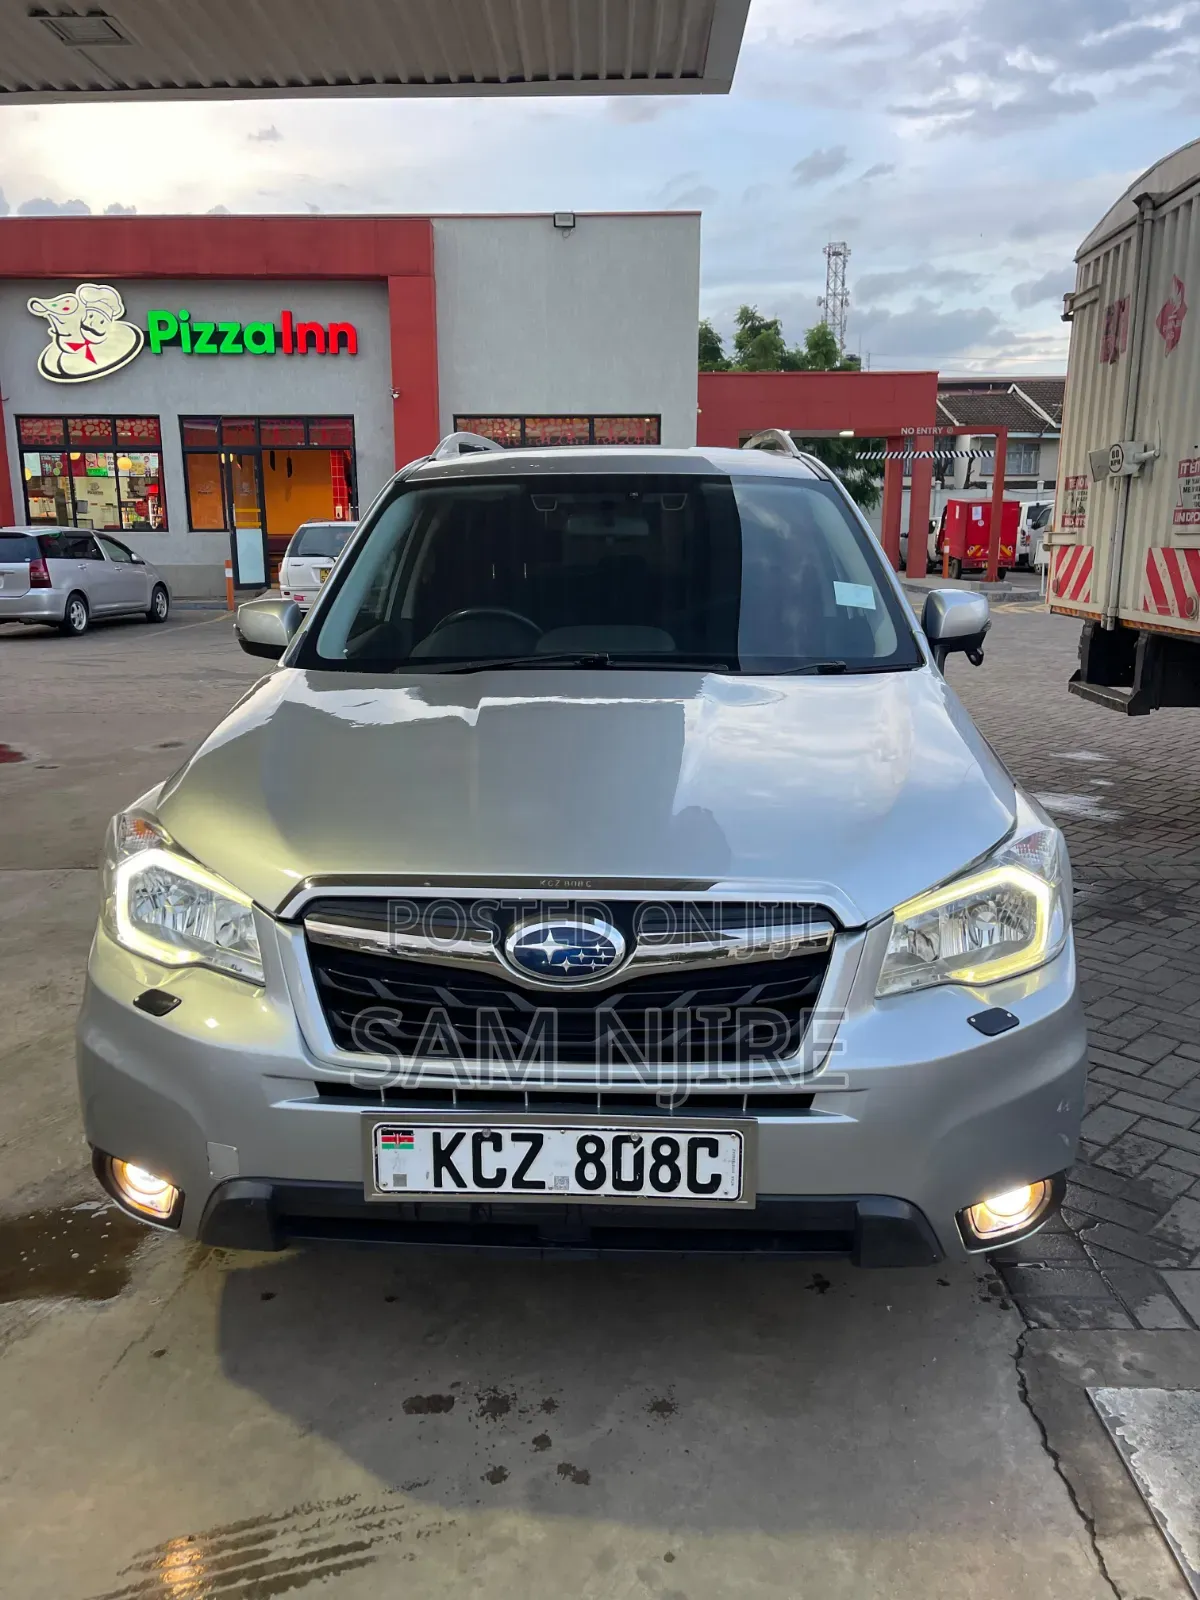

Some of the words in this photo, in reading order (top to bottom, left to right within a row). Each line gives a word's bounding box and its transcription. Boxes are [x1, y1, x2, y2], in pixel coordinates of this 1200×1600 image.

[901, 427, 915, 435] NO
[916, 427, 944, 435] ENTRY
[432, 1131, 546, 1190] KCZ
[574, 1133, 723, 1195] 808C
